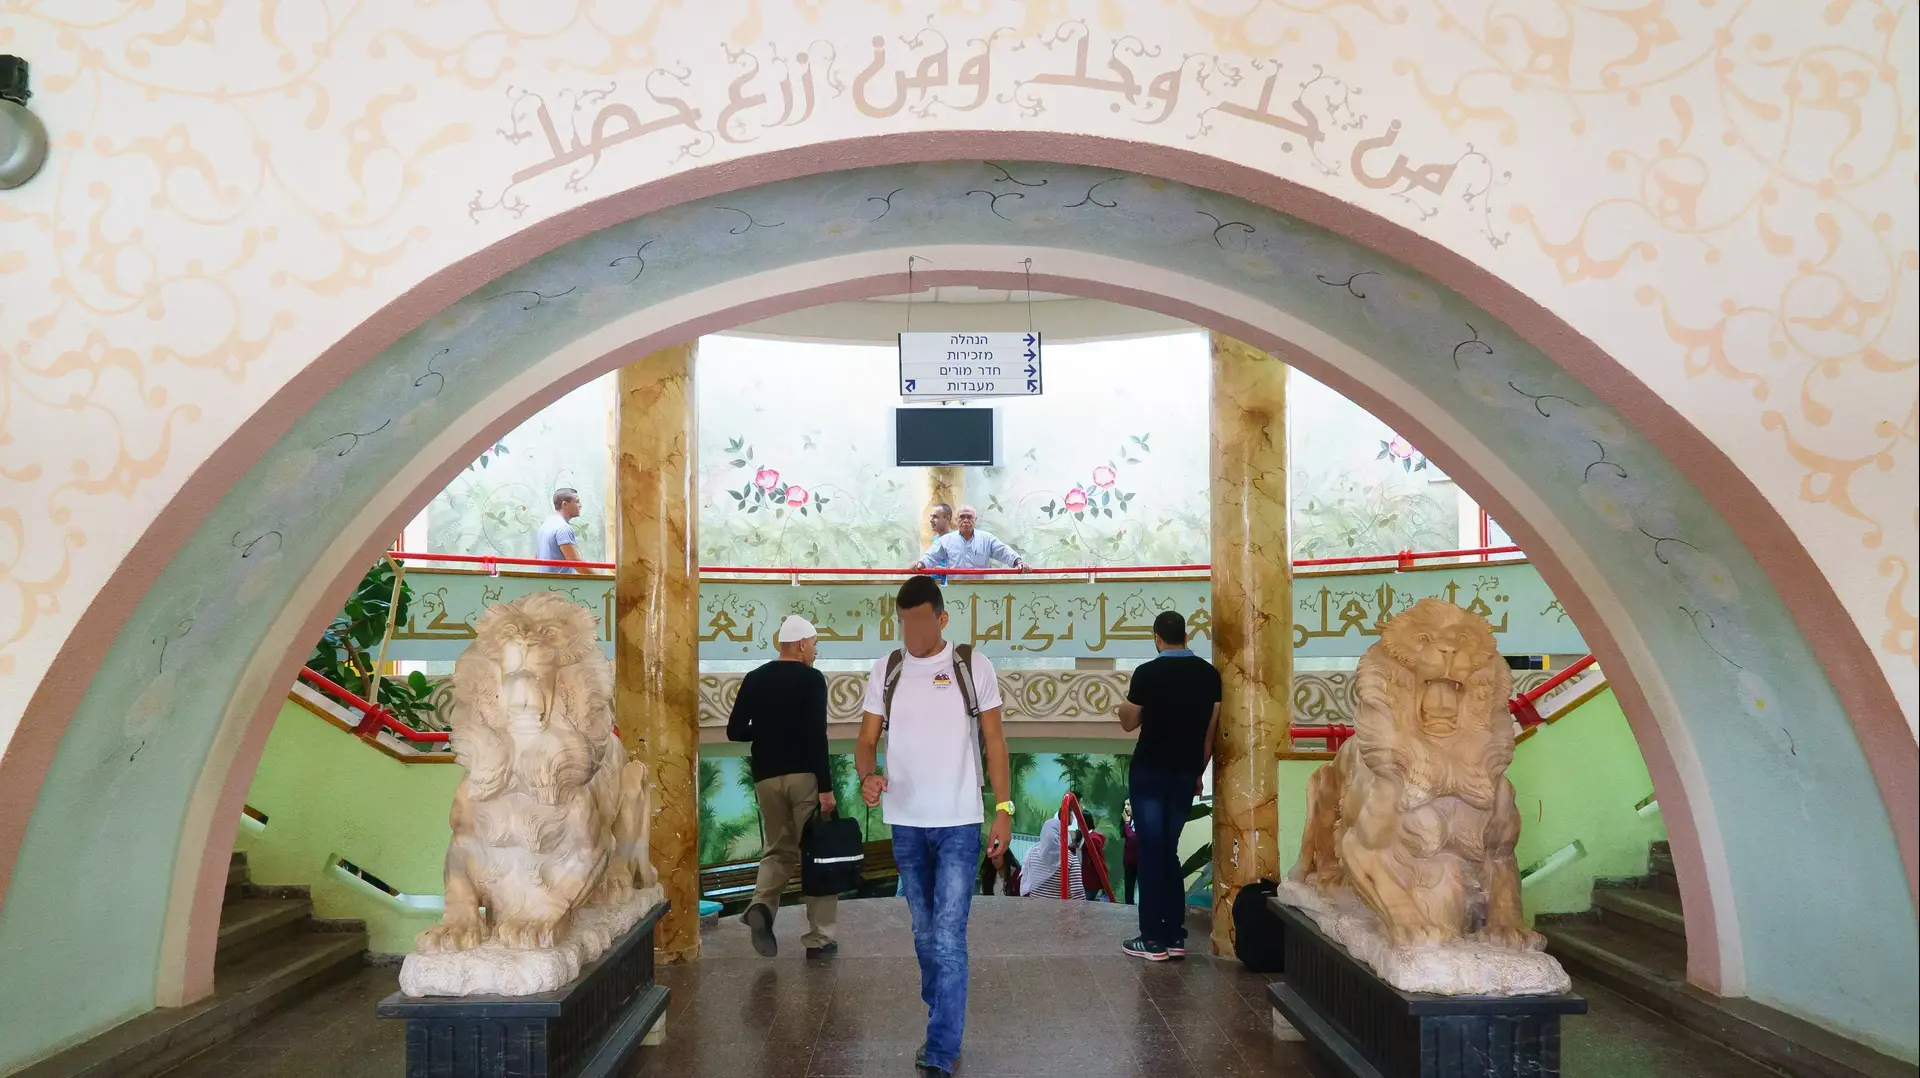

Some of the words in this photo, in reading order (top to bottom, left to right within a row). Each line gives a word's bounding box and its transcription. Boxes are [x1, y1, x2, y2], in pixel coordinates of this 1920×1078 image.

[852, 35, 990, 119] ومن
[716, 51, 816, 144] زرع
[1350, 119, 1459, 196] من
[950, 333, 988, 345] הנהלה
[947, 350, 993, 361] מזכירות
[939, 365, 972, 376] מורים
[978, 365, 1001, 376] חדר
[947, 381, 995, 392] מעבדות
